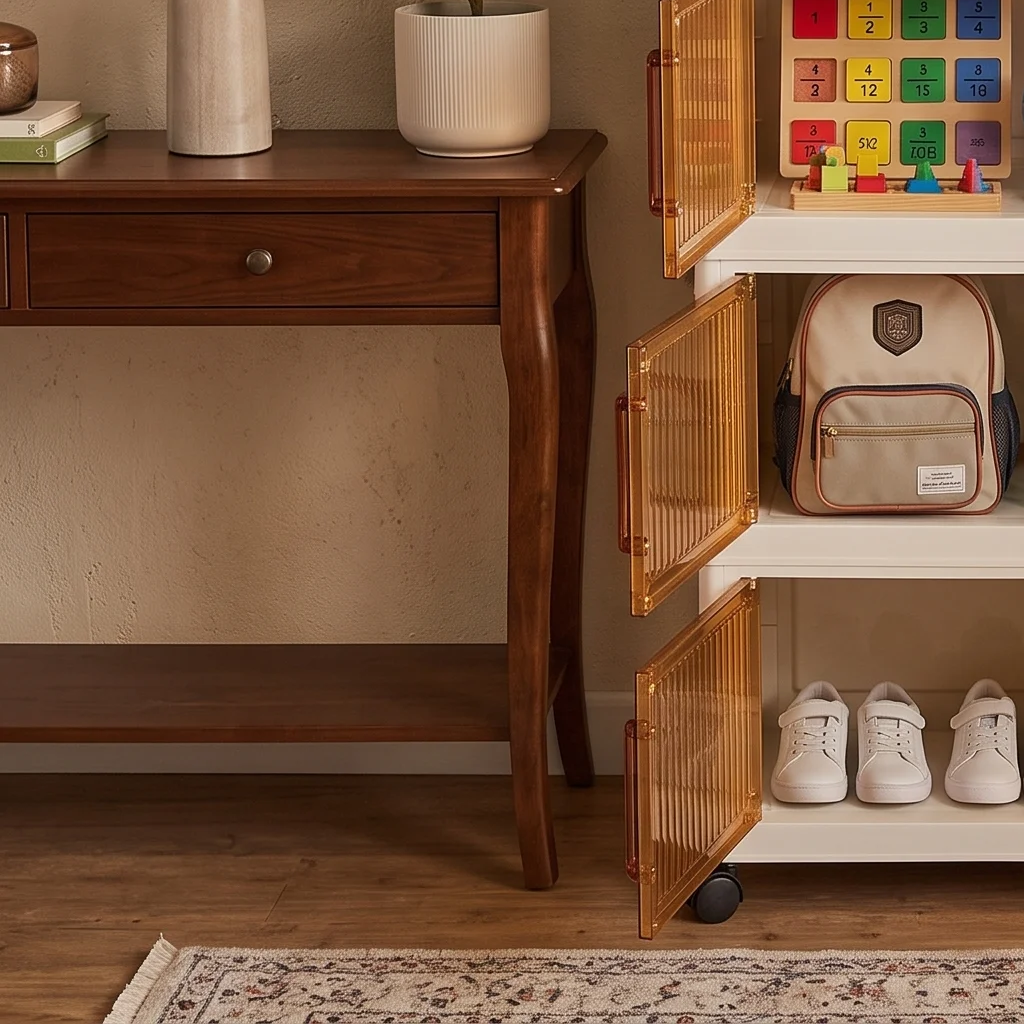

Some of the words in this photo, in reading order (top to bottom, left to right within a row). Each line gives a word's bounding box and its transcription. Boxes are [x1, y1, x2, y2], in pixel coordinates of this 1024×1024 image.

[866, 2, 873, 12] 1
[811, 11, 818, 24] 1
[865, 21, 874, 34] 2
[919, 21, 928, 34] 3
[973, 21, 983, 34] 4
[864, 64, 872, 76] 4
[860, 83, 878, 97] 12
[915, 84, 930, 96] 15
[919, 127, 927, 138] 3
